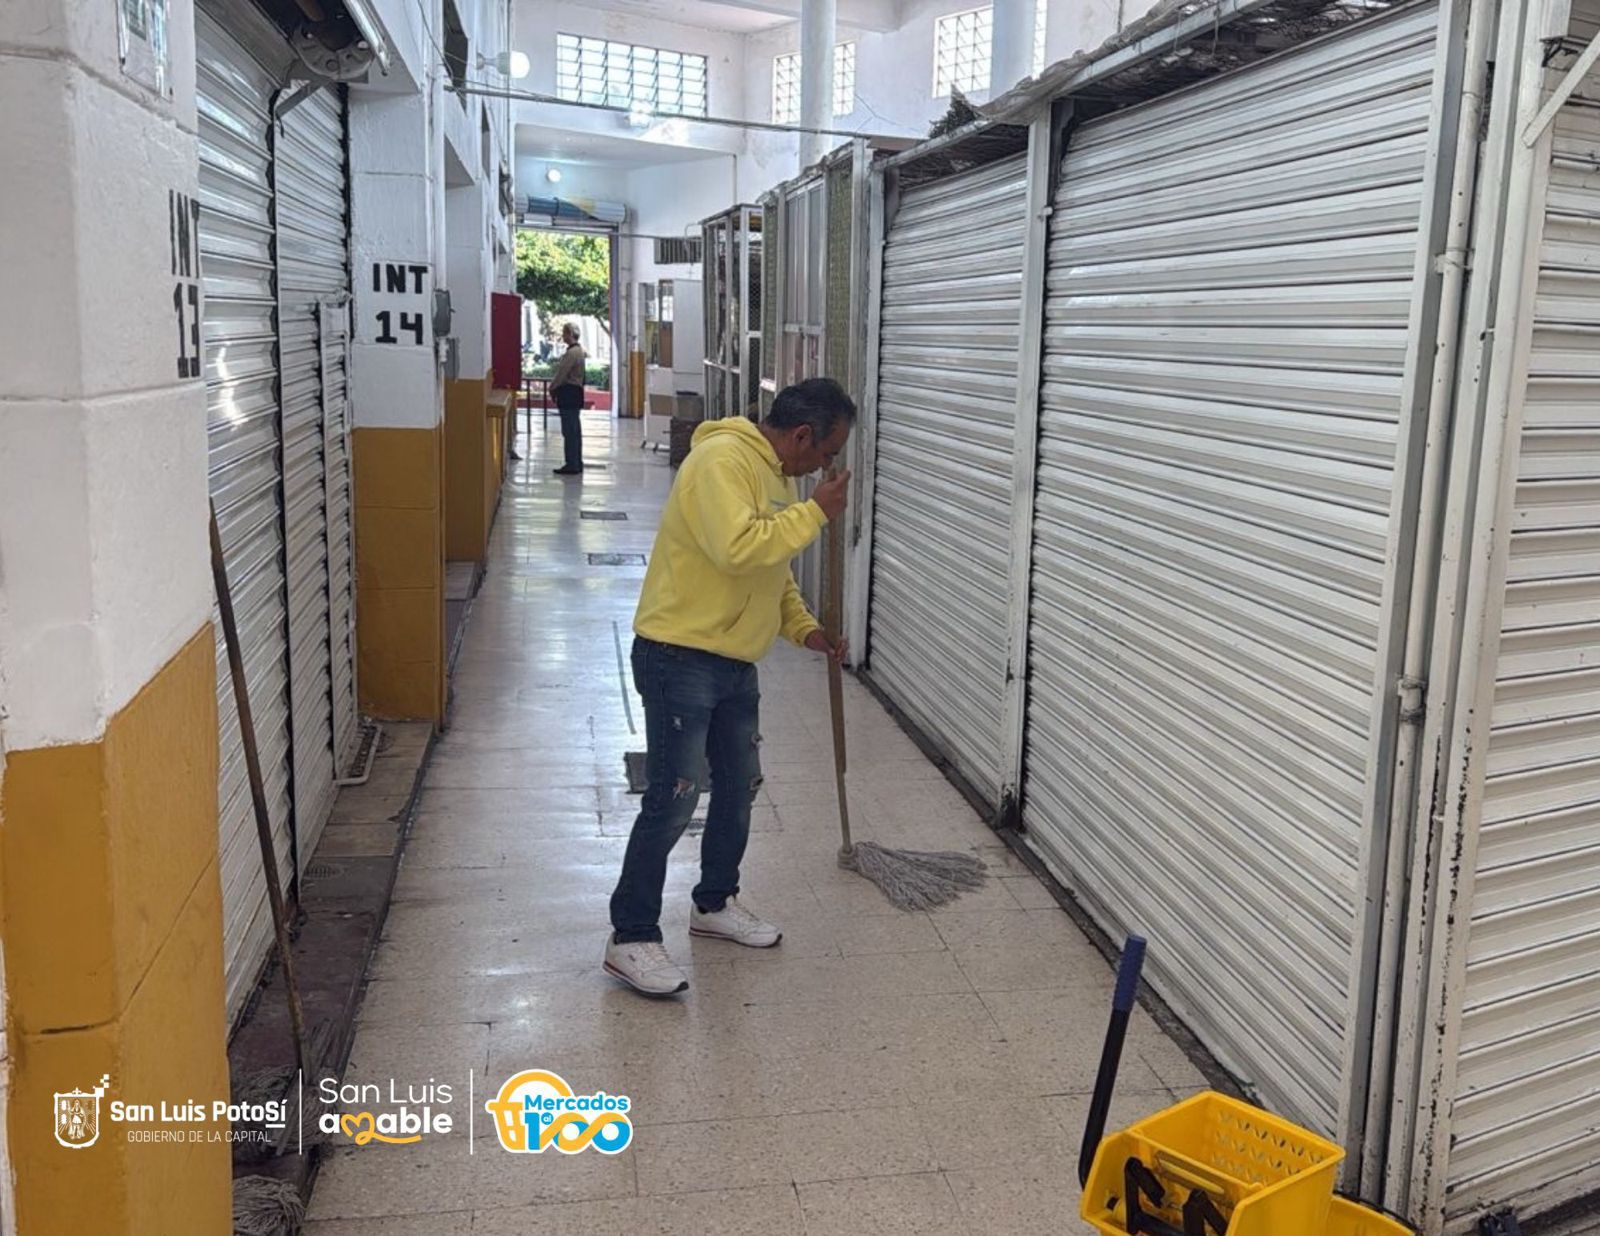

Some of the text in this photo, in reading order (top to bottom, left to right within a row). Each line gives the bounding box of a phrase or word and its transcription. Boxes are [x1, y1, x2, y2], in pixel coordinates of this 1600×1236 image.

[169, 189, 200, 279] INT
[373, 263, 428, 294] INT
[173, 282, 200, 379] 13
[375, 310, 423, 346] 14
